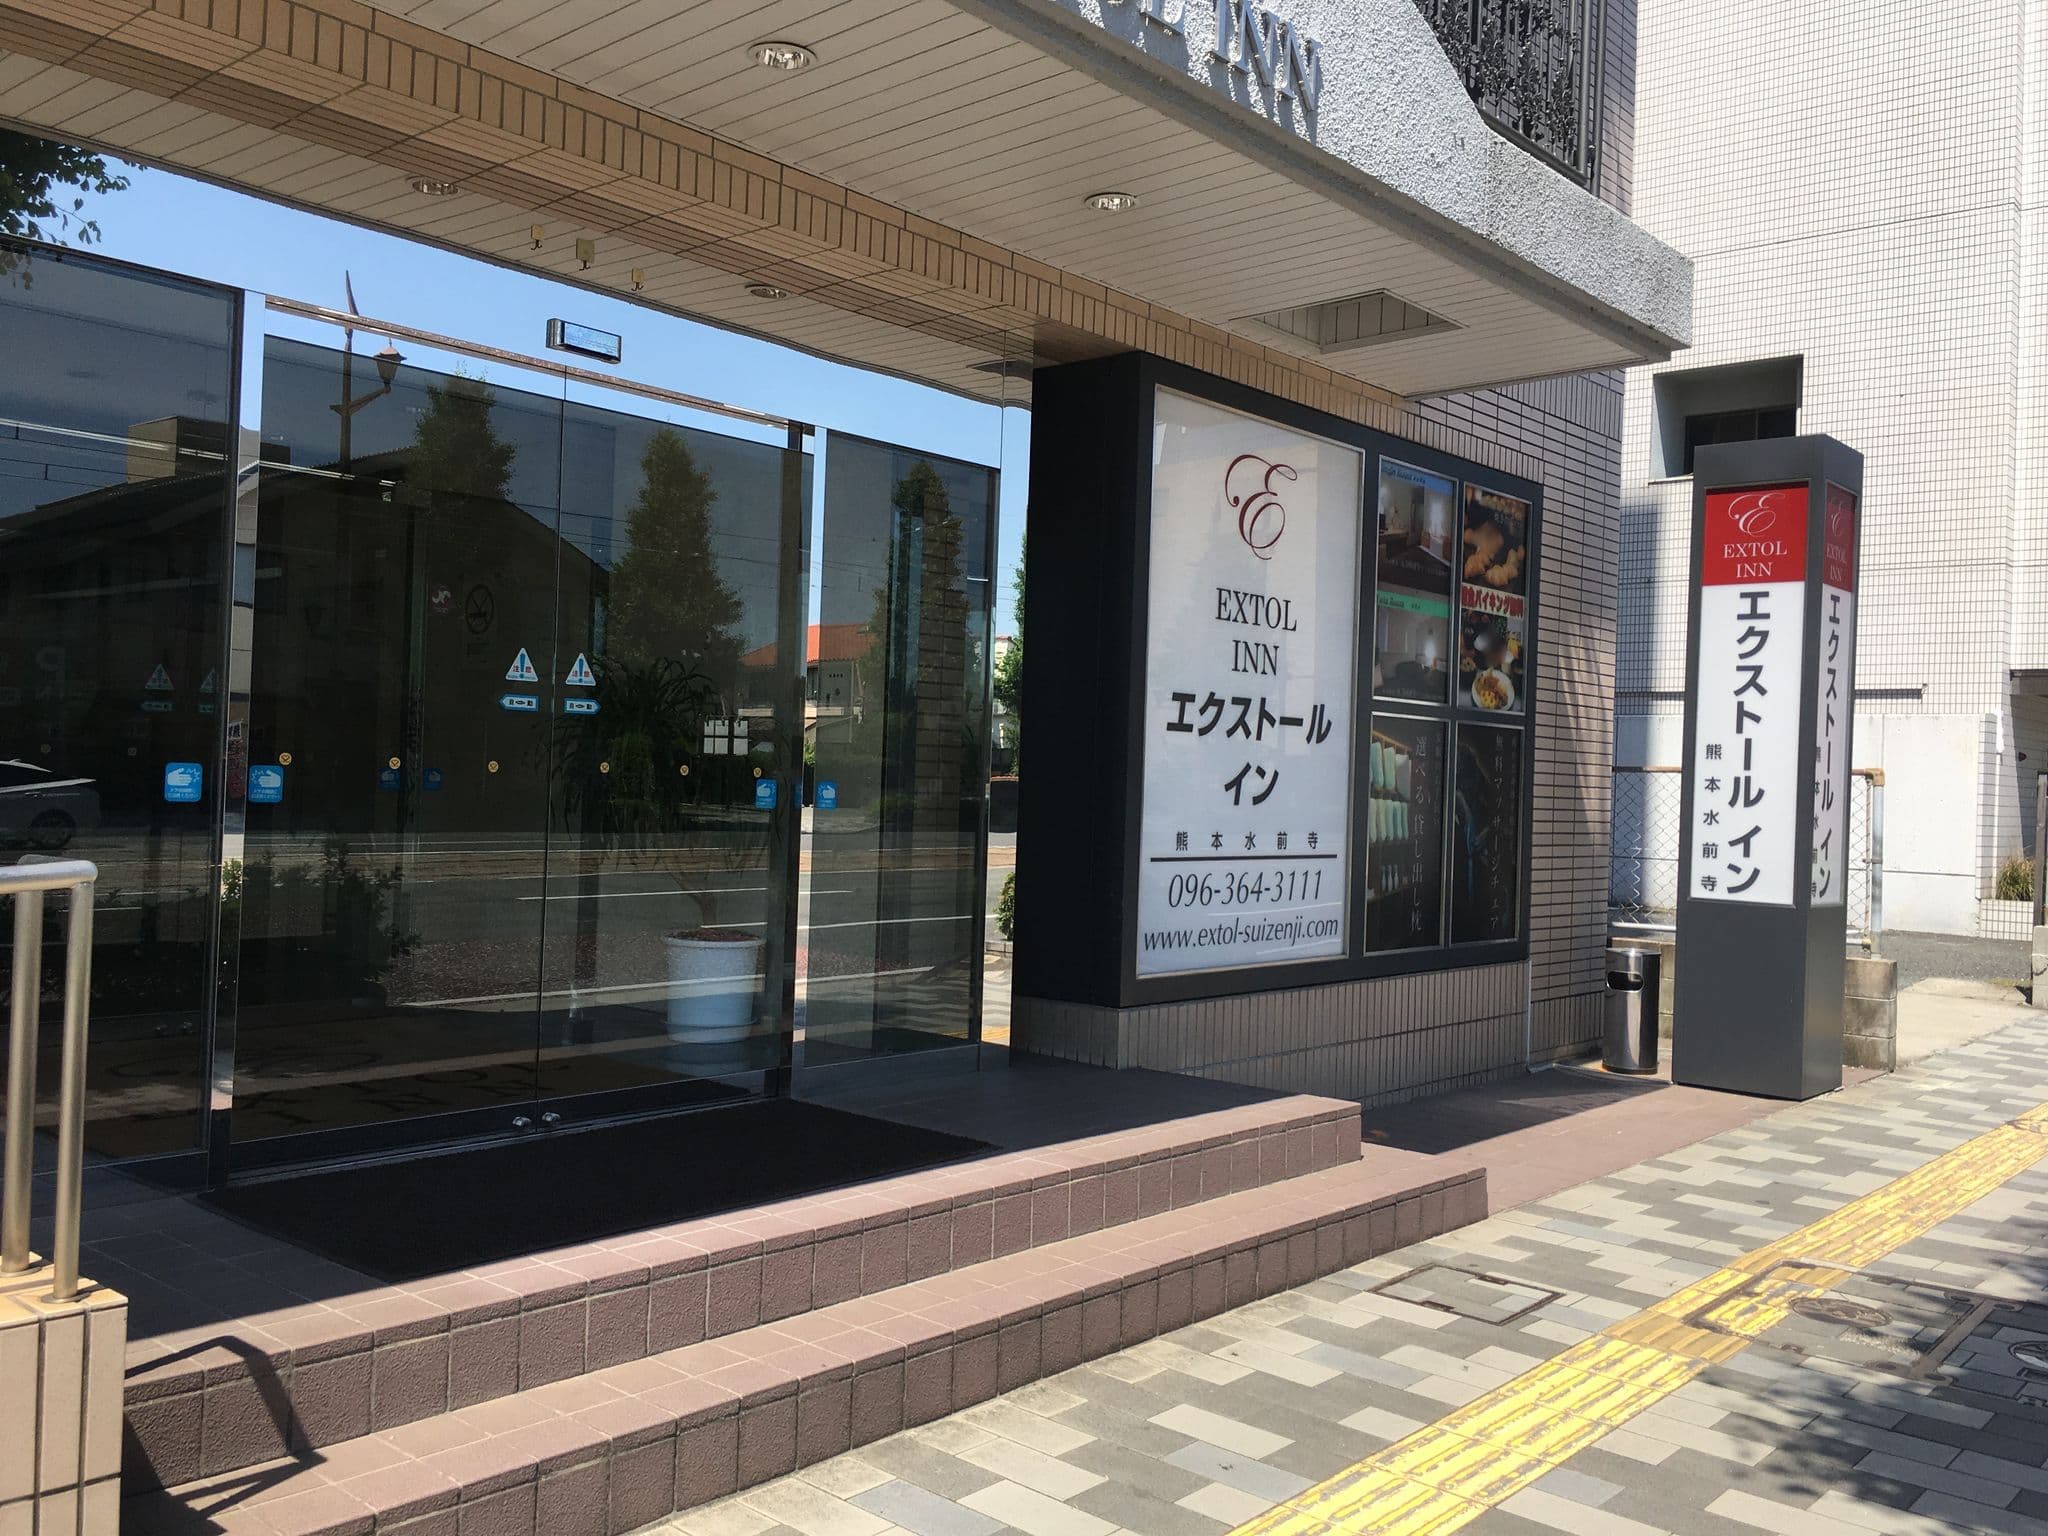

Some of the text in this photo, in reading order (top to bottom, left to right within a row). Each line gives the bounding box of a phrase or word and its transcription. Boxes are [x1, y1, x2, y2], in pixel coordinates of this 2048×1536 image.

[1723, 540, 1788, 558] EXTOL
[1735, 561, 1773, 578] INN
[1215, 587, 1298, 633] EXTOL
[1231, 639, 1280, 677] INN
[1166, 691, 1333, 745] エクストール
[1223, 763, 1280, 807] イン
[1700, 743, 1723, 892] 熊本水前寺
[1175, 830, 1319, 852] 熊本水前寺
[1168, 869, 1322, 909] 096-364-3111
[1143, 914, 1339, 952] www.extol-suizenji.com
